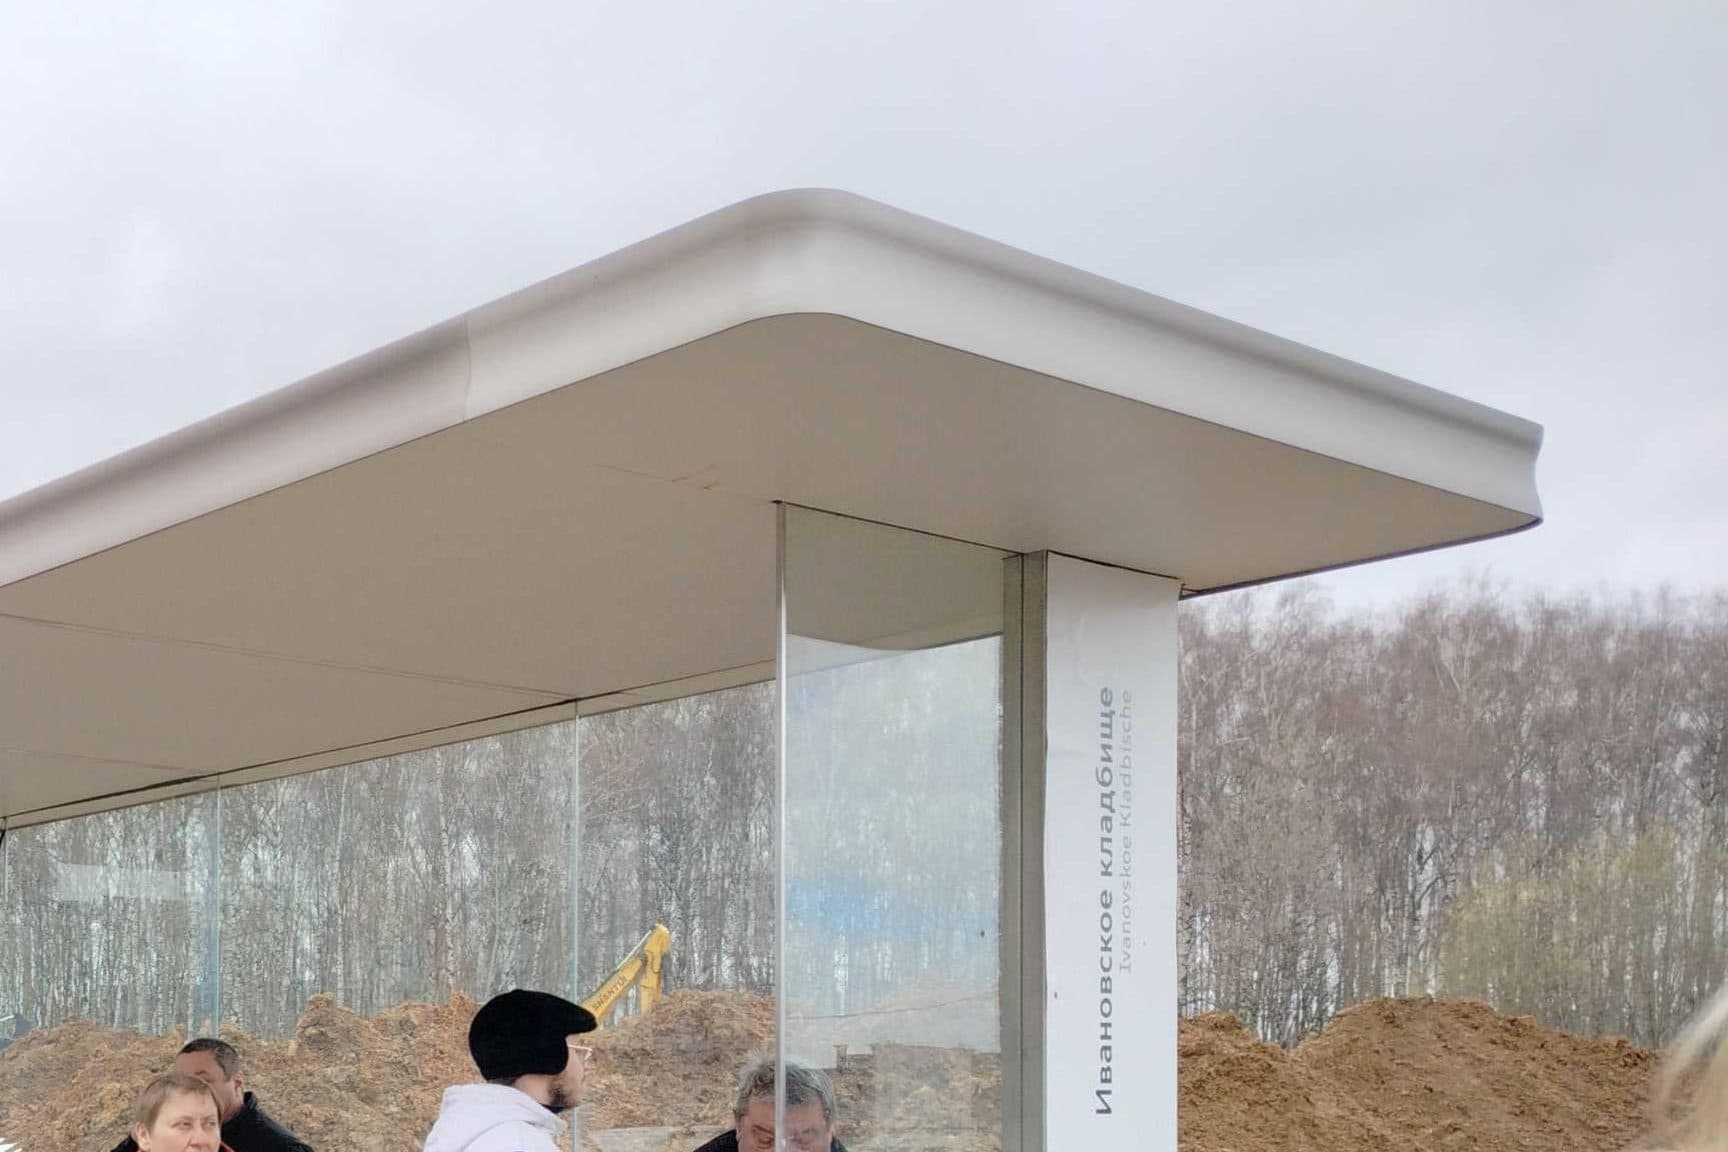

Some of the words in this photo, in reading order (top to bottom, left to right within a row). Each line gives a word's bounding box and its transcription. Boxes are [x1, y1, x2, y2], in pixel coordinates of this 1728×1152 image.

[1095, 686, 1116, 878] кладбище
[1119, 690, 1133, 827] Kladbische
[1119, 836, 1133, 973] Ivanovskoe
[1095, 888, 1113, 1115] Ивановское
